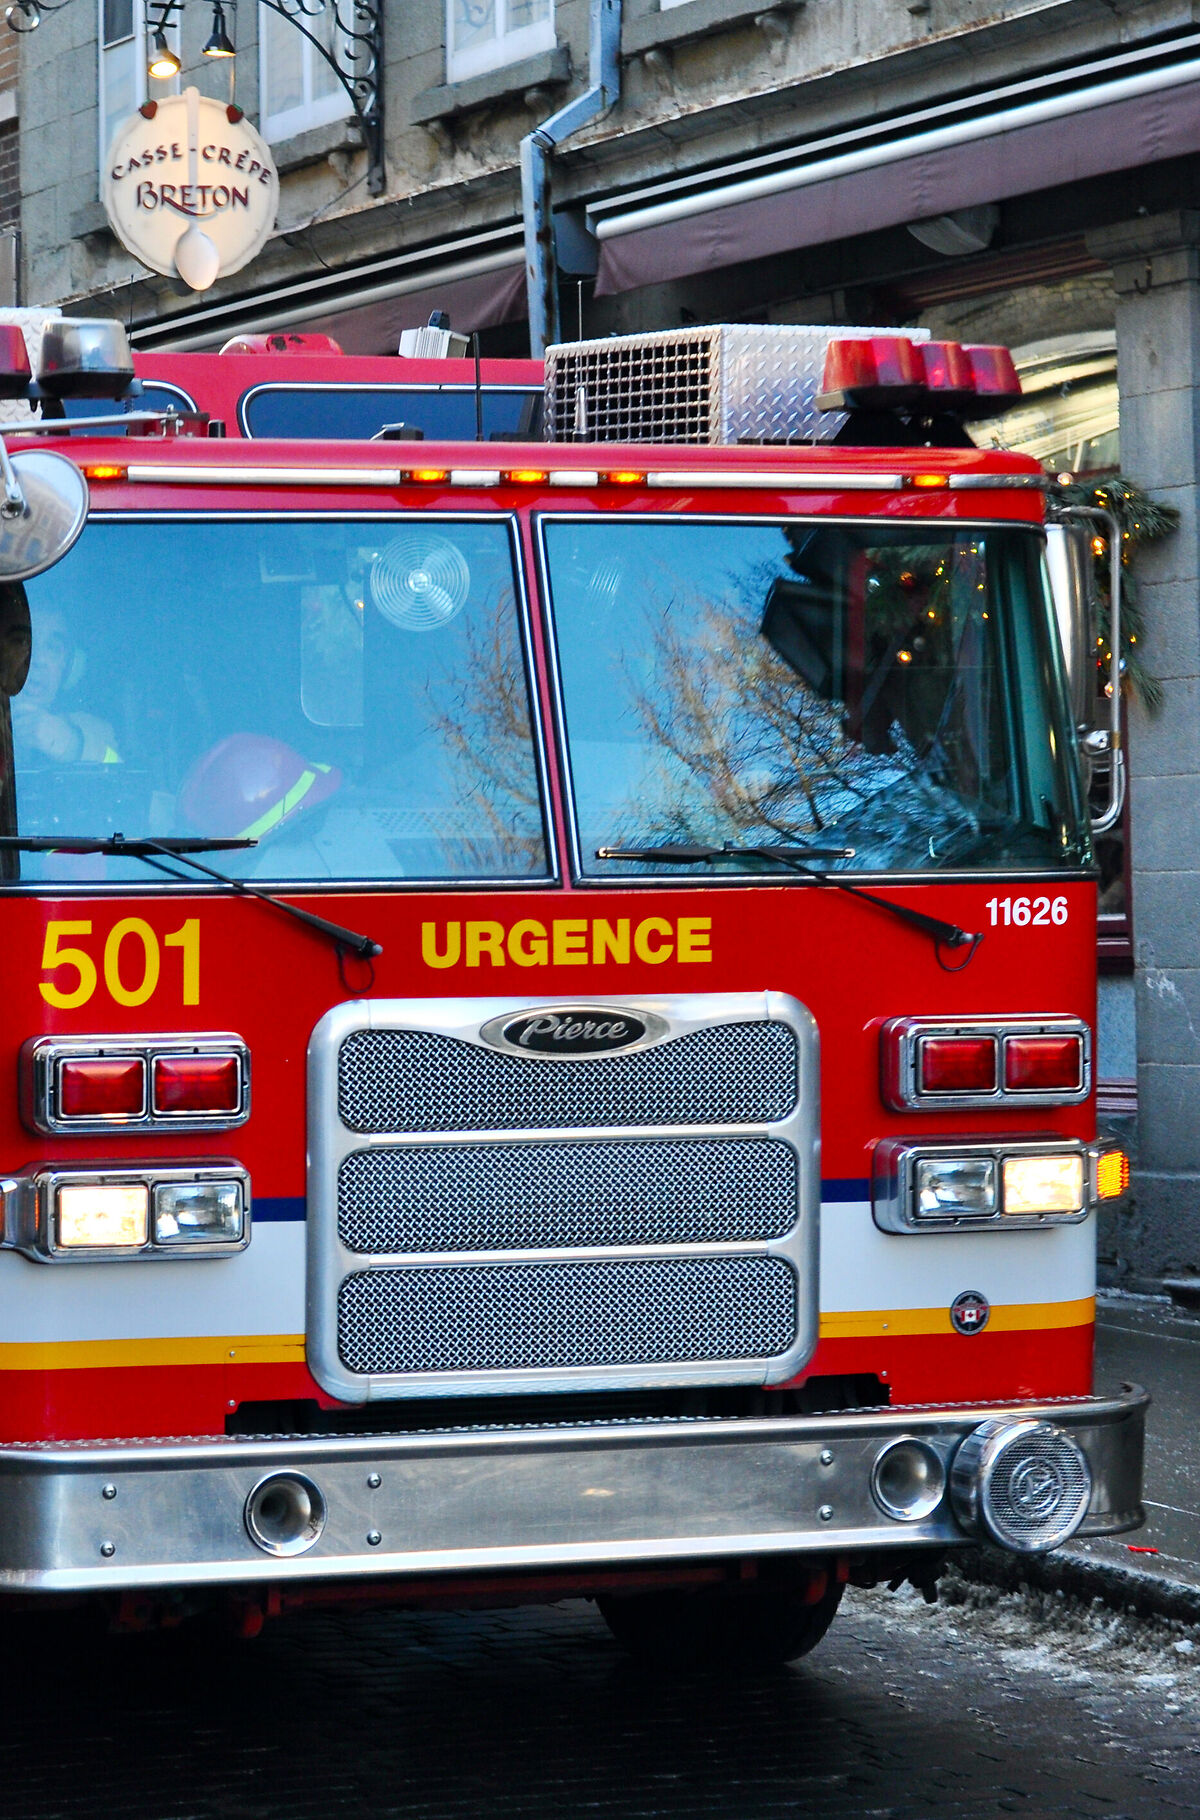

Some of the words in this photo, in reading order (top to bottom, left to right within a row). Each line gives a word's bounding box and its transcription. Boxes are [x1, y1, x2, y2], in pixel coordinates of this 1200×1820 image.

[137, 181, 249, 217] BRETON
[985, 896, 1068, 926] 11626
[421, 916, 713, 969] URGENCE
[38, 917, 200, 1009] 501
[519, 1014, 629, 1046] Pierce
